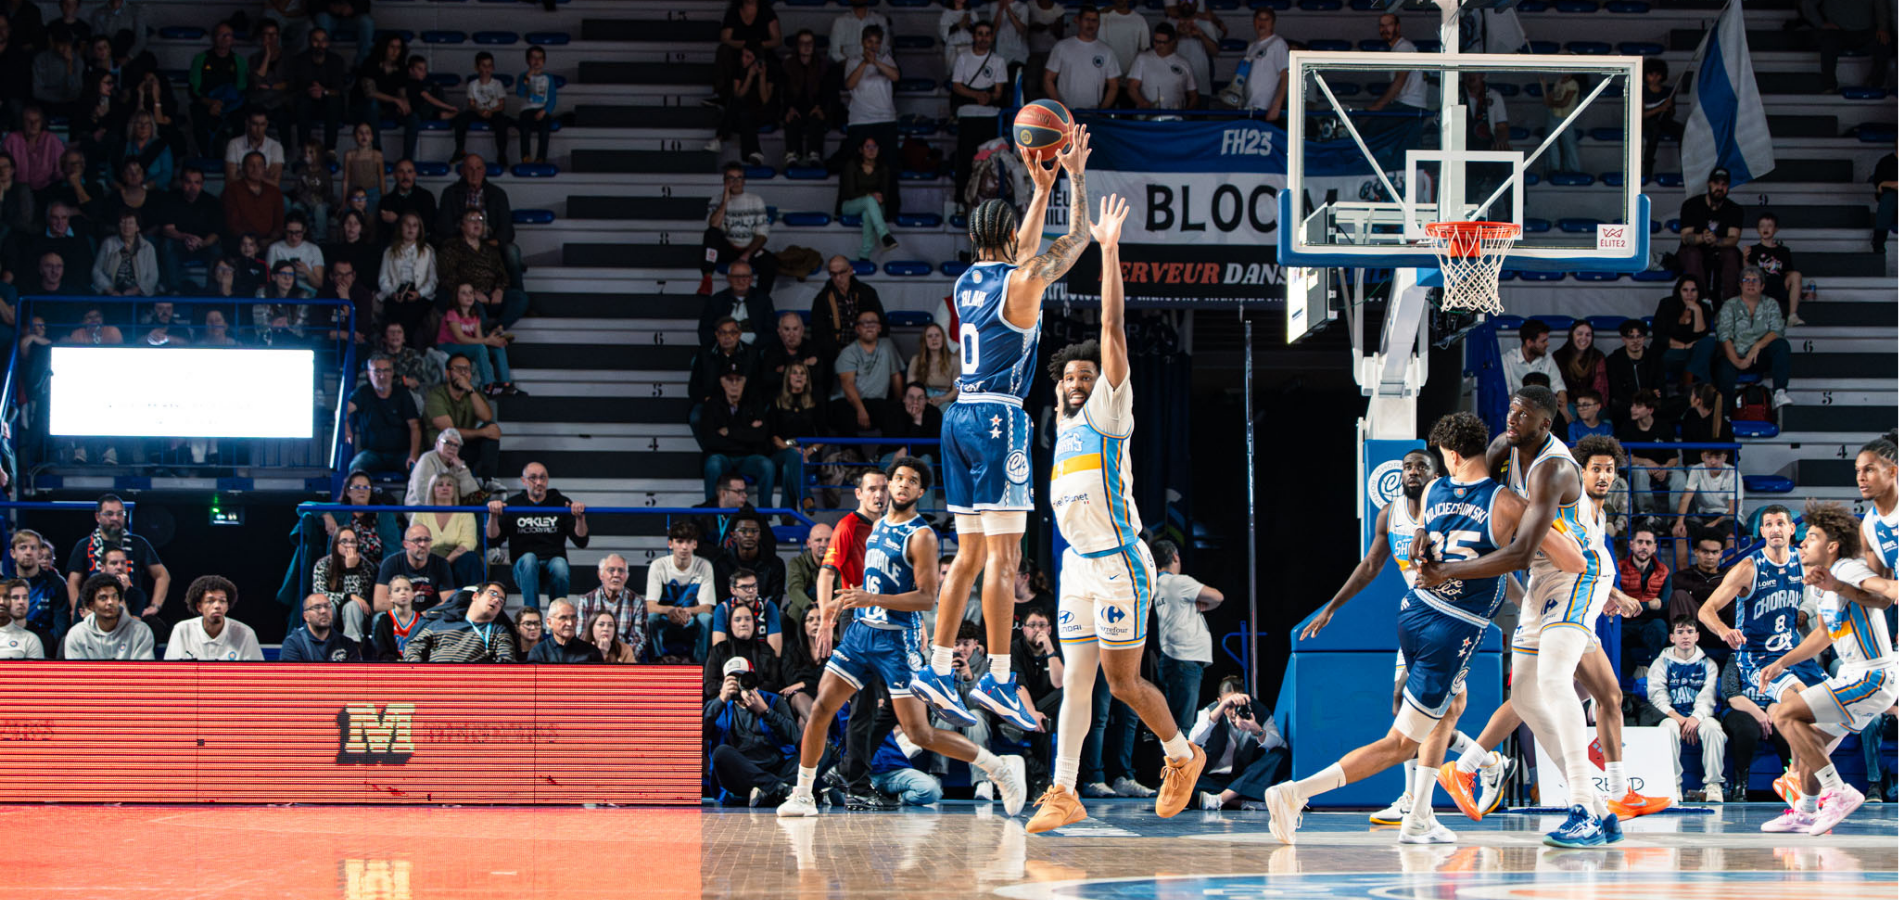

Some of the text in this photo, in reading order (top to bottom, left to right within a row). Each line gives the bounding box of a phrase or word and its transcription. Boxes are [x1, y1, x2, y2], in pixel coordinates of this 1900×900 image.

[1145, 184, 1277, 233] BLOC
[1600, 239, 1626, 248] ÉLITE2
[1098, 261, 1220, 284] ERVEUR
[959, 322, 980, 375] 0
[652, 382, 662, 399] 5
[1822, 390, 1833, 406] 5
[648, 437, 659, 452] 4
[1837, 443, 1848, 459] 4
[645, 491, 656, 507] 3
[1854, 499, 1864, 513] 3
[1425, 502, 1489, 525] WOJCIECHOWSKI
[516, 516, 558, 528] OAKLEY
[1753, 589, 1803, 620] CHORAL
[1774, 614, 1786, 633] 8
